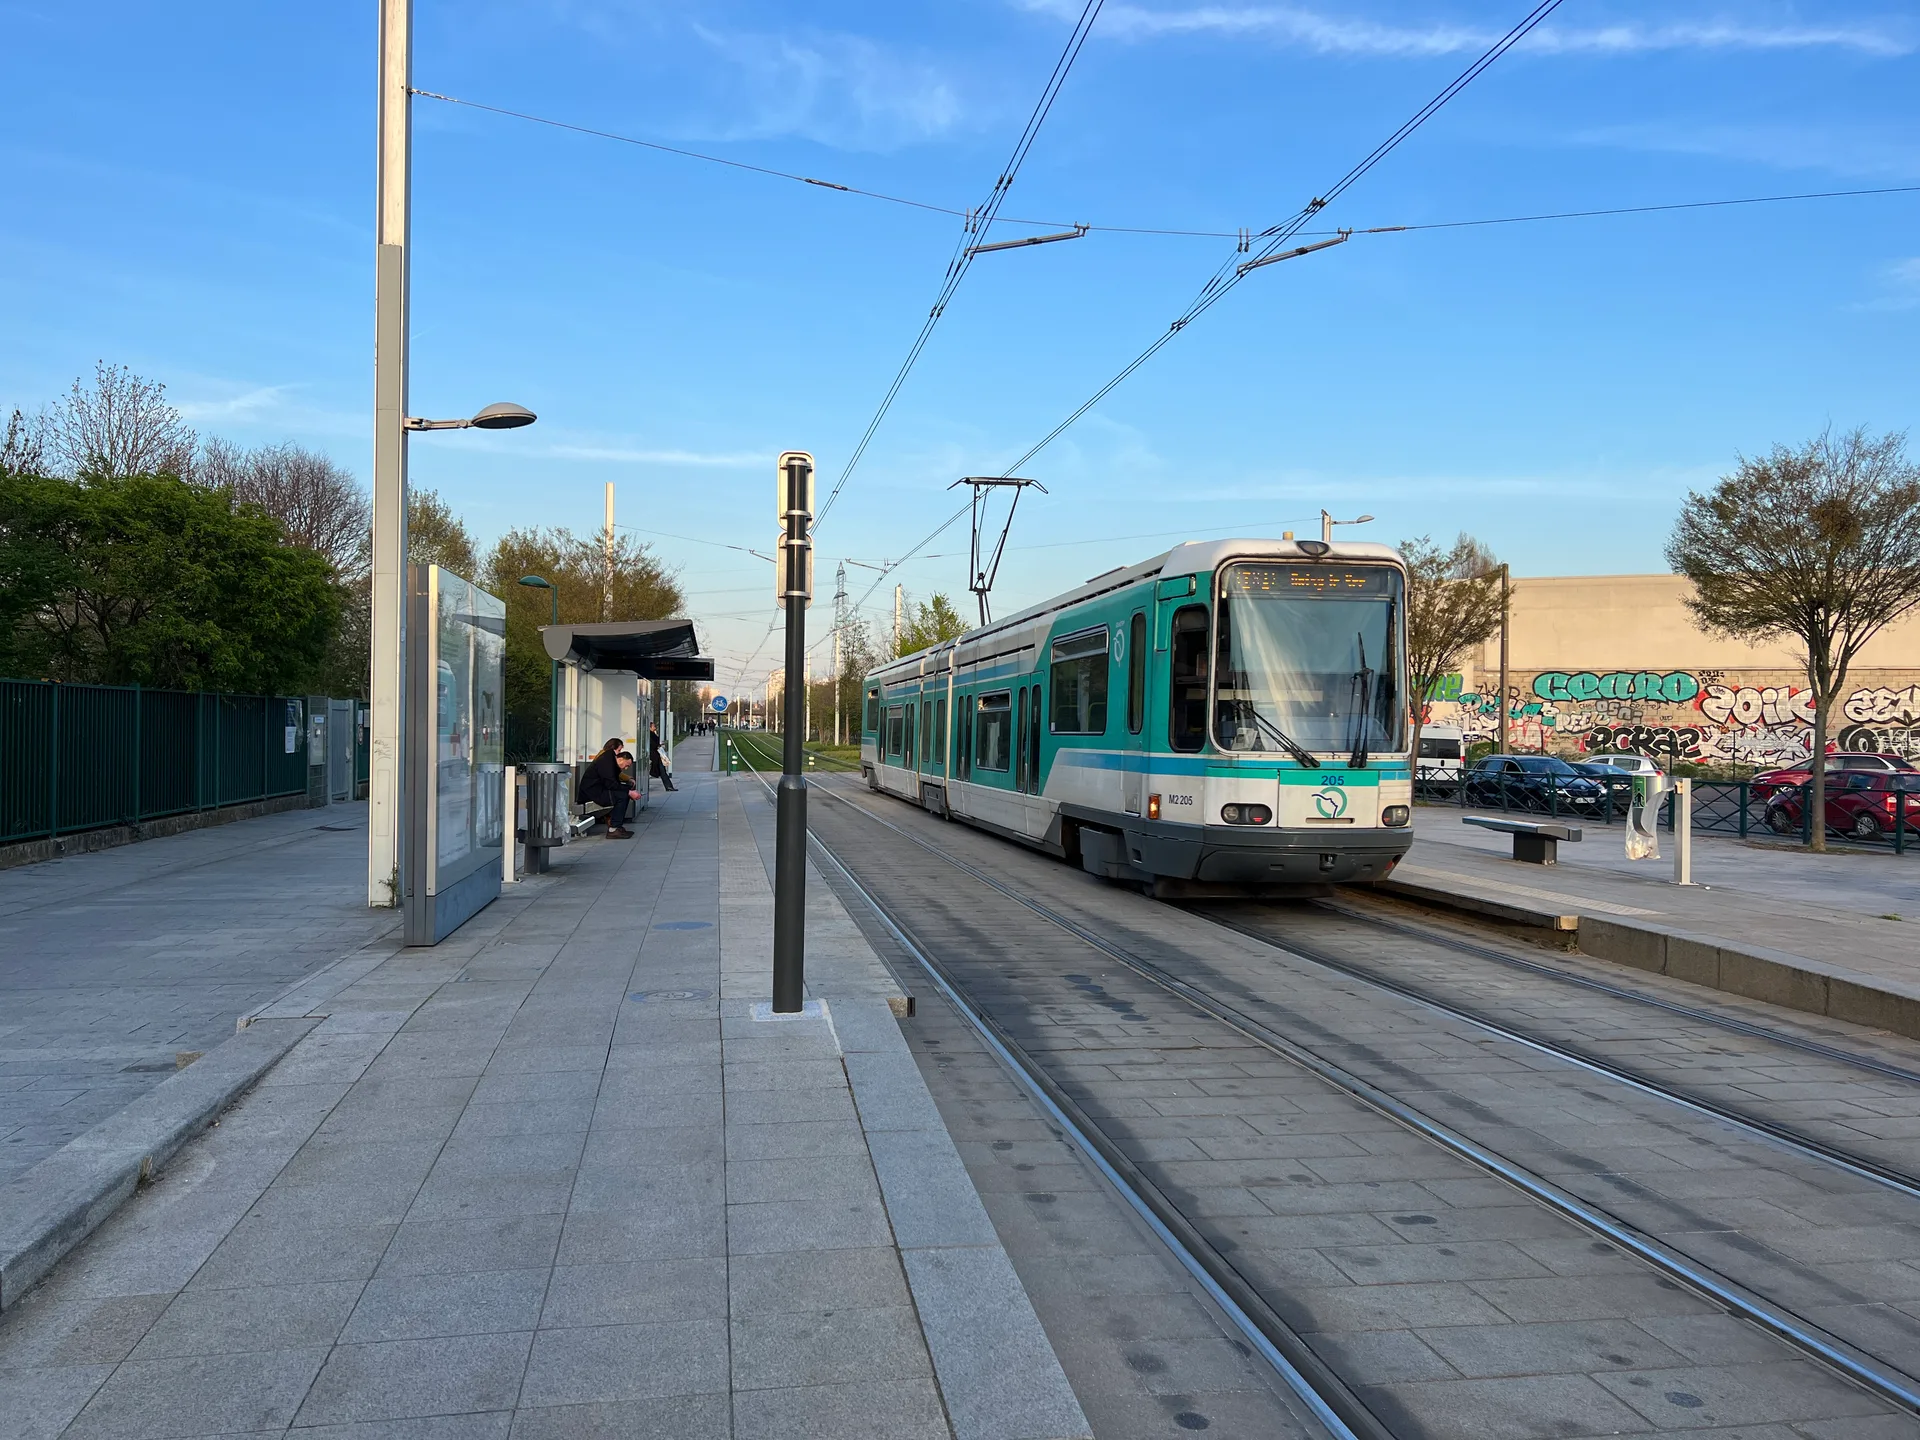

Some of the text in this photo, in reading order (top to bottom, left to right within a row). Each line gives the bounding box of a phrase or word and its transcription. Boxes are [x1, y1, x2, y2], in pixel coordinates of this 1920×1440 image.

[1321, 775, 1345, 786] 205
[1168, 794, 1193, 806] M2 205
